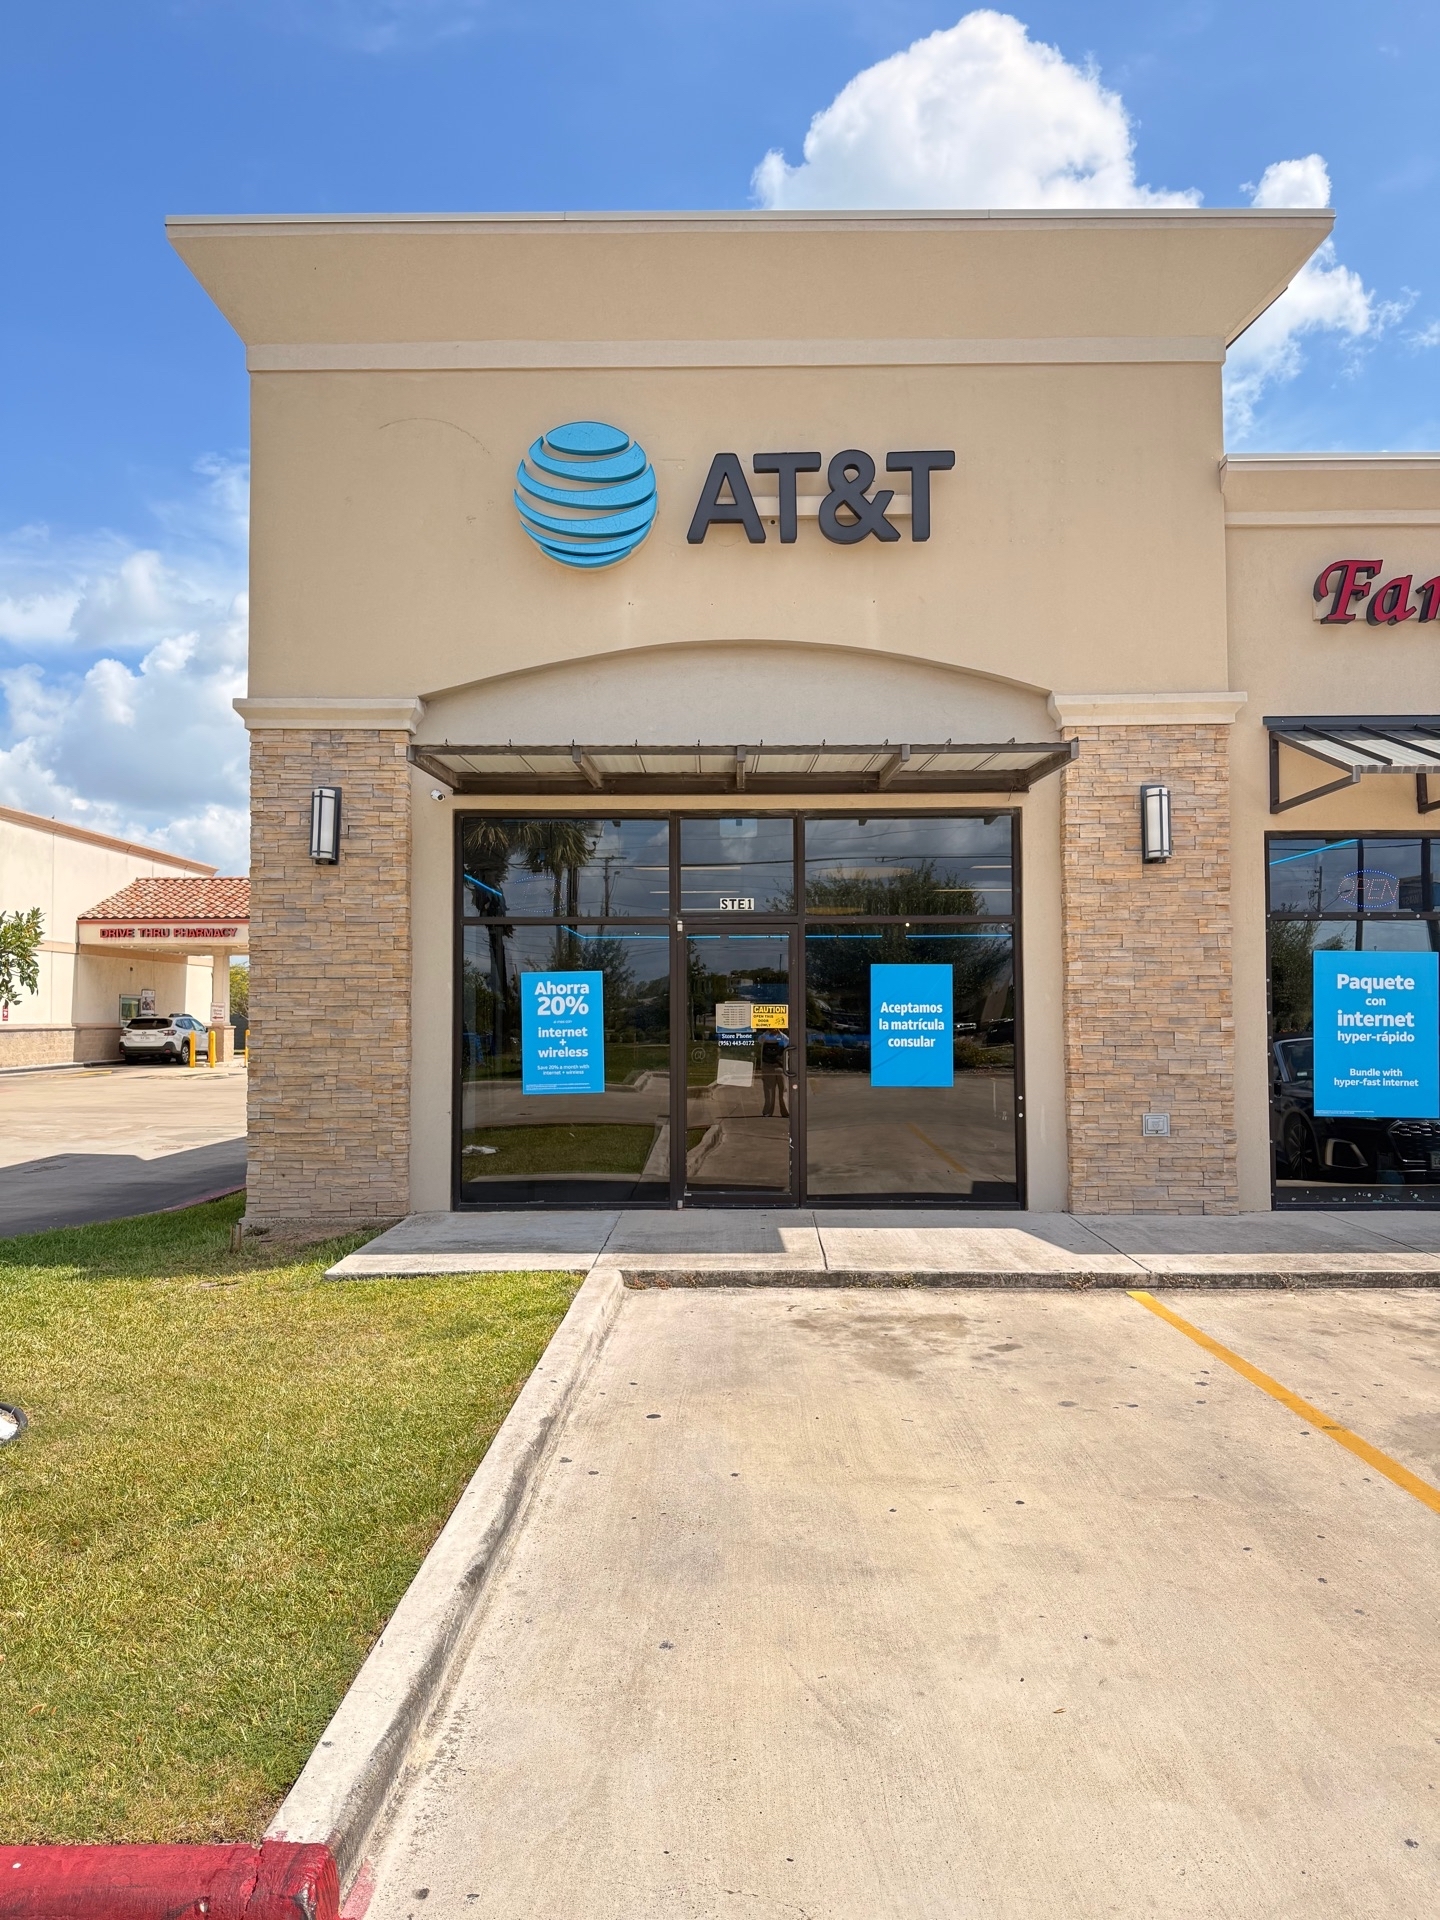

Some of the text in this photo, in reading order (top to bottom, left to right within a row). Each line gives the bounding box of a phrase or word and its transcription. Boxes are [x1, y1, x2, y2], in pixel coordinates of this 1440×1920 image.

[686, 449, 955, 544] AT&T
[1338, 878, 1400, 900] OPEN
[721, 898, 753, 910] STE1
[99, 927, 238, 938] DRIVE THRU PHARMACY
[534, 981, 590, 995] Ahorra
[1336, 973, 1415, 993] Paquete
[537, 996, 589, 1015] 20%
[1365, 997, 1386, 1006] con
[880, 1002, 943, 1016] Aceptamos
[879, 1018, 945, 1030] la matrícula
[1337, 1009, 1415, 1027] internet
[538, 1027, 588, 1038] internet
[1337, 1030, 1415, 1044] hyper-rápido
[888, 1036, 936, 1047] consular
[538, 1047, 589, 1058] wireless
[1349, 1068, 1403, 1077] Bundle with
[1334, 1077, 1419, 1088] hyper-fast internet
